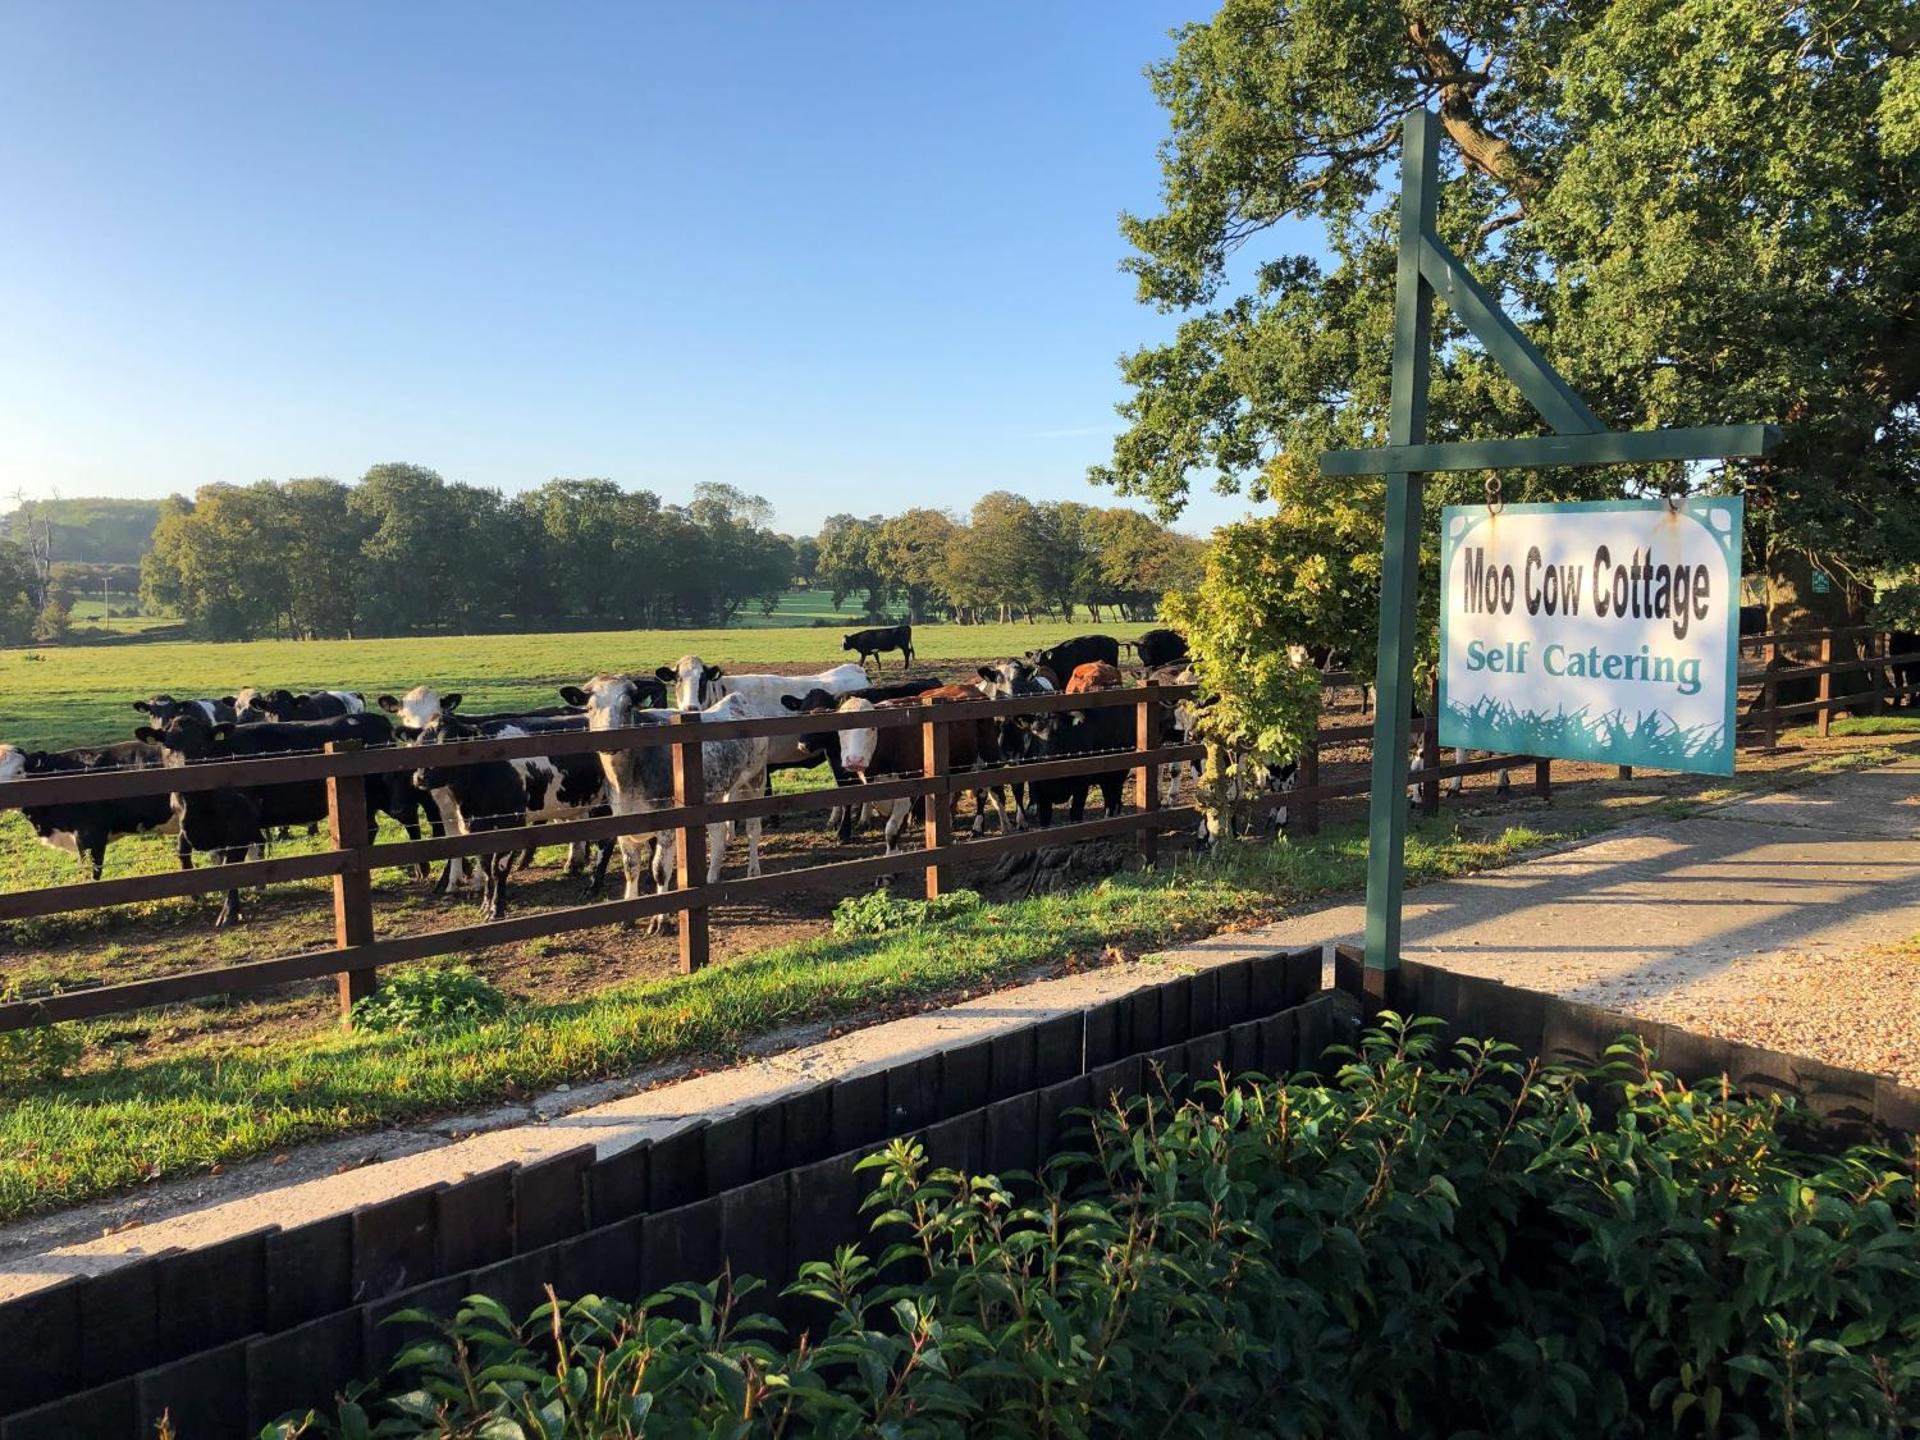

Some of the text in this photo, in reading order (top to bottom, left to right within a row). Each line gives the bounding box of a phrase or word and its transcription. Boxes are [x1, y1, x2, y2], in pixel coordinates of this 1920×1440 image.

[1464, 545, 1710, 640] Moo Cow Cottage
[1466, 640, 1702, 695] Self Catering
